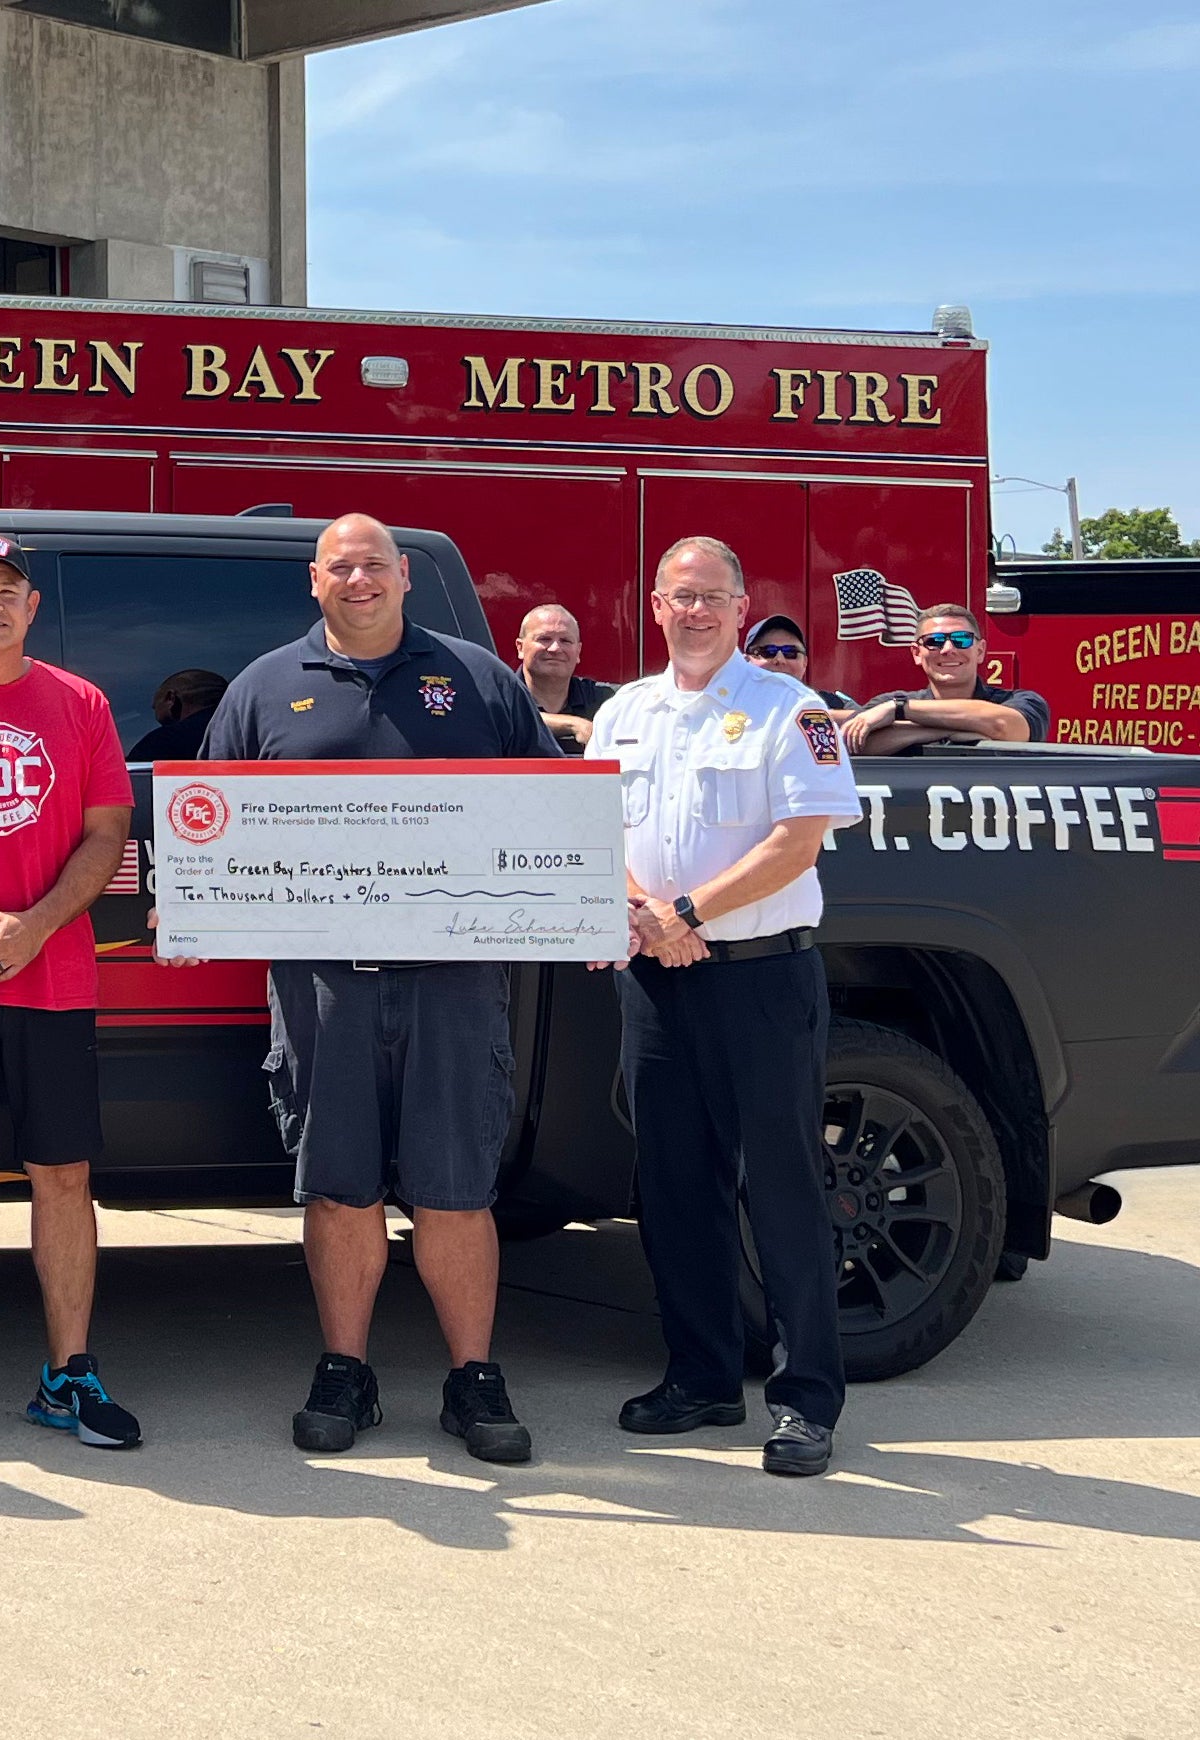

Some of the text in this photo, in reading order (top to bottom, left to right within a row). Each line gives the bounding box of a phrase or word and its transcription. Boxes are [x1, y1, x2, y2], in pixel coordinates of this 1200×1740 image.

[182, 343, 335, 402] BAY
[462, 355, 942, 426] METRO FIRE
[1075, 622, 1161, 674] GREEN
[987, 659, 1003, 685] 2
[1092, 683, 1140, 710] FIRE
[1056, 718, 1184, 747] PARAMEDIC
[241, 801, 464, 815] Fire Department Coffee Foundation
[241, 816, 429, 827] 811 W. Riverside Blvd. Rockford, IL 61103
[167, 854, 214, 864] Pay to the
[226, 857, 270, 876] Green
[273, 860, 294, 880] Bay
[175, 867, 215, 876] Order of
[175, 885, 204, 901] Ten
[209, 886, 275, 902] Thousand
[285, 887, 334, 904] Dollars
[580, 896, 615, 905] Dollars
[168, 934, 198, 943] Memo
[473, 935, 575, 946] Authorized Signature
